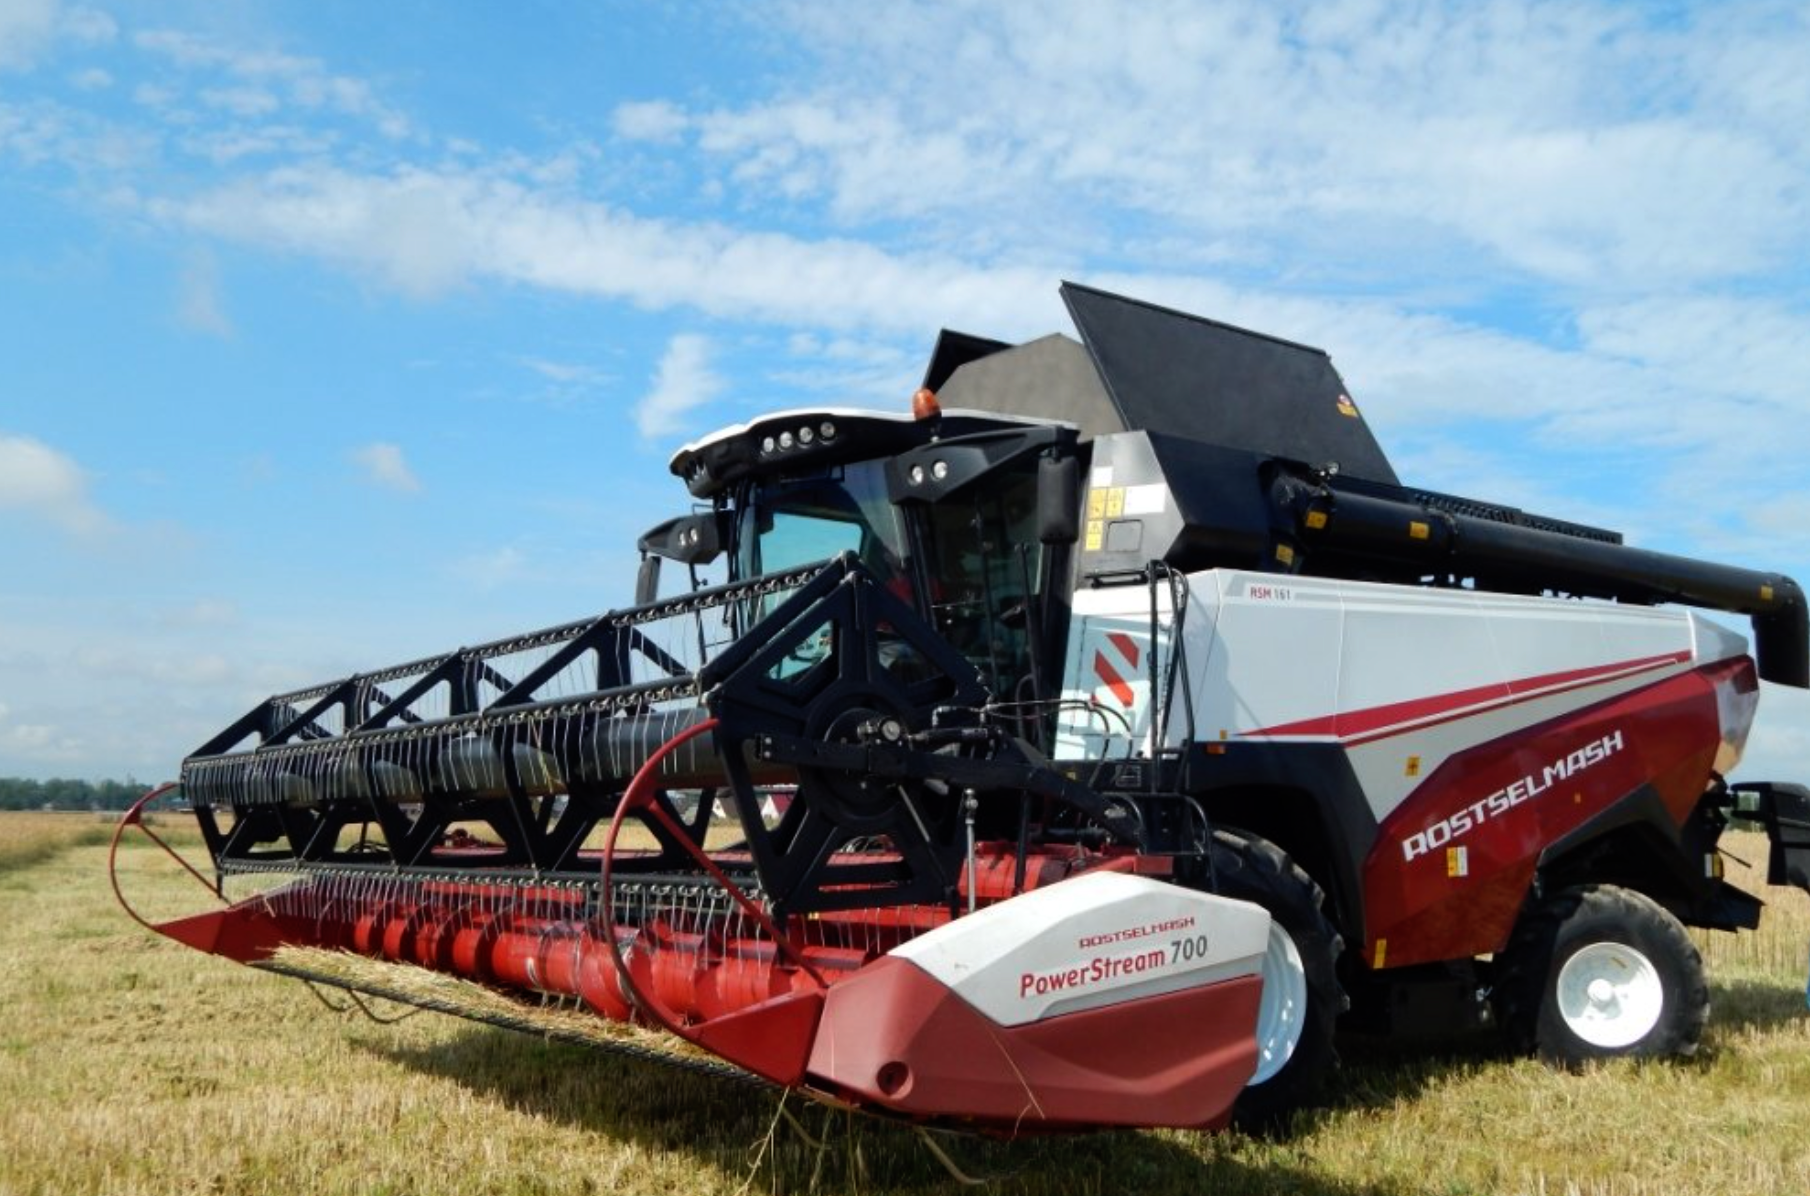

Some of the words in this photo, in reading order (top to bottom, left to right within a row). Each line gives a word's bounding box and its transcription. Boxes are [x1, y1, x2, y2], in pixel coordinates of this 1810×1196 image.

[1250, 586, 1272, 599] RSM
[1274, 588, 1291, 600] 161
[1402, 730, 1624, 862] ROSTSELMASH
[1079, 917, 1195, 949] ROSTSELMASH
[1020, 949, 1165, 998] PowerStream
[1171, 935, 1208, 964] 700
